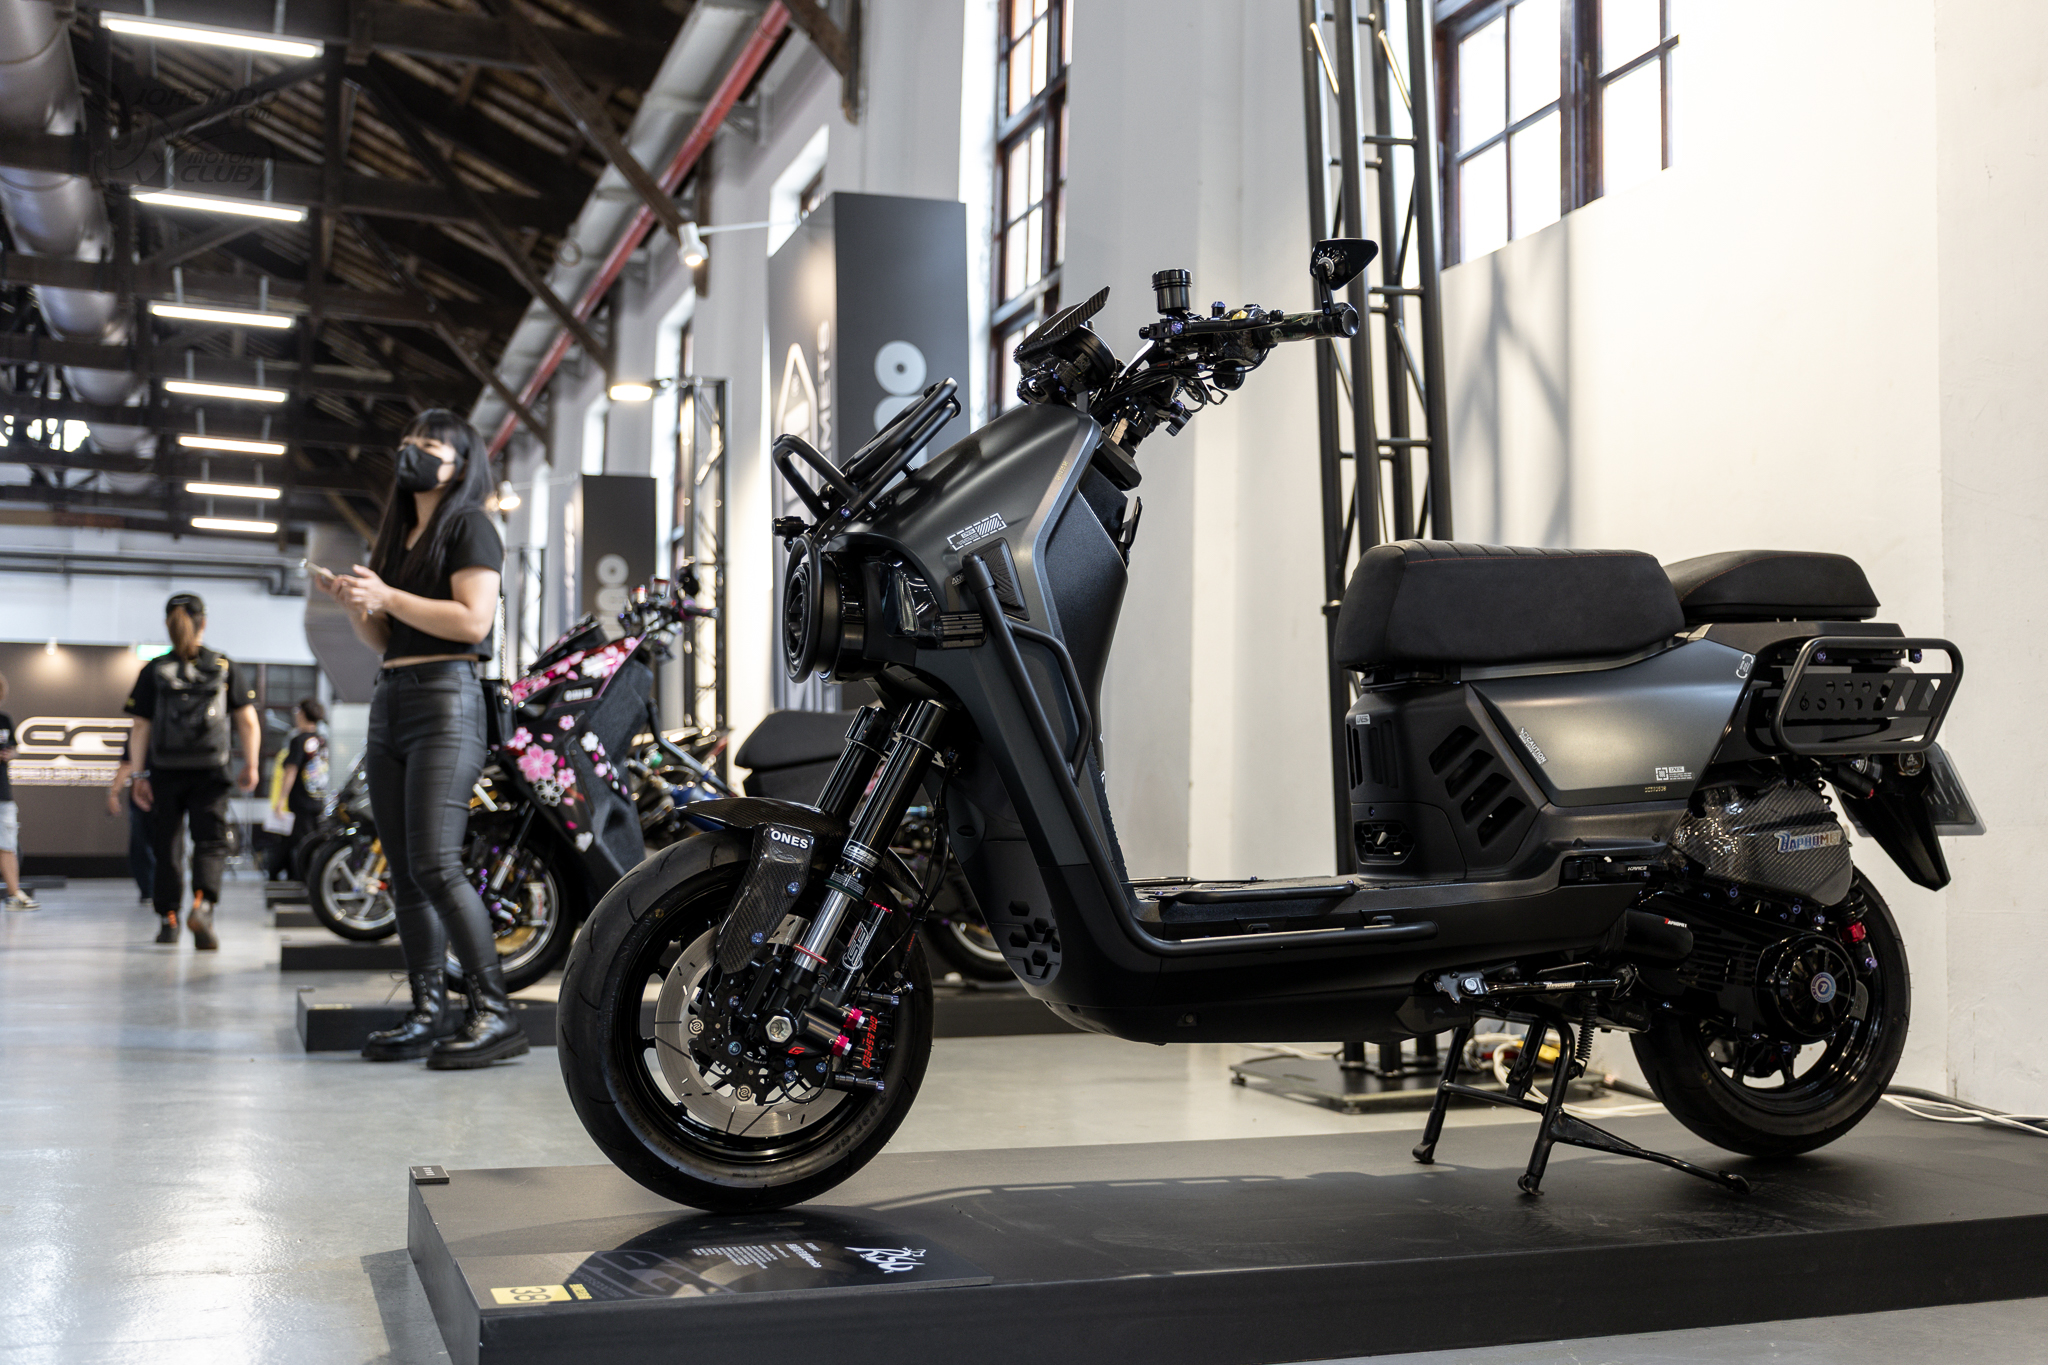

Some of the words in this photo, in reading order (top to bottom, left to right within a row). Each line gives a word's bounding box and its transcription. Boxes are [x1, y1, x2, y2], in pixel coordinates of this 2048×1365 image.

[1526, 736, 1547, 763] CAUTION
[770, 830, 809, 849] ONES
[1773, 829, 1843, 853] BAPHOMET
[861, 1015, 879, 1069] GALESPEED
[509, 1286, 552, 1302] 38
